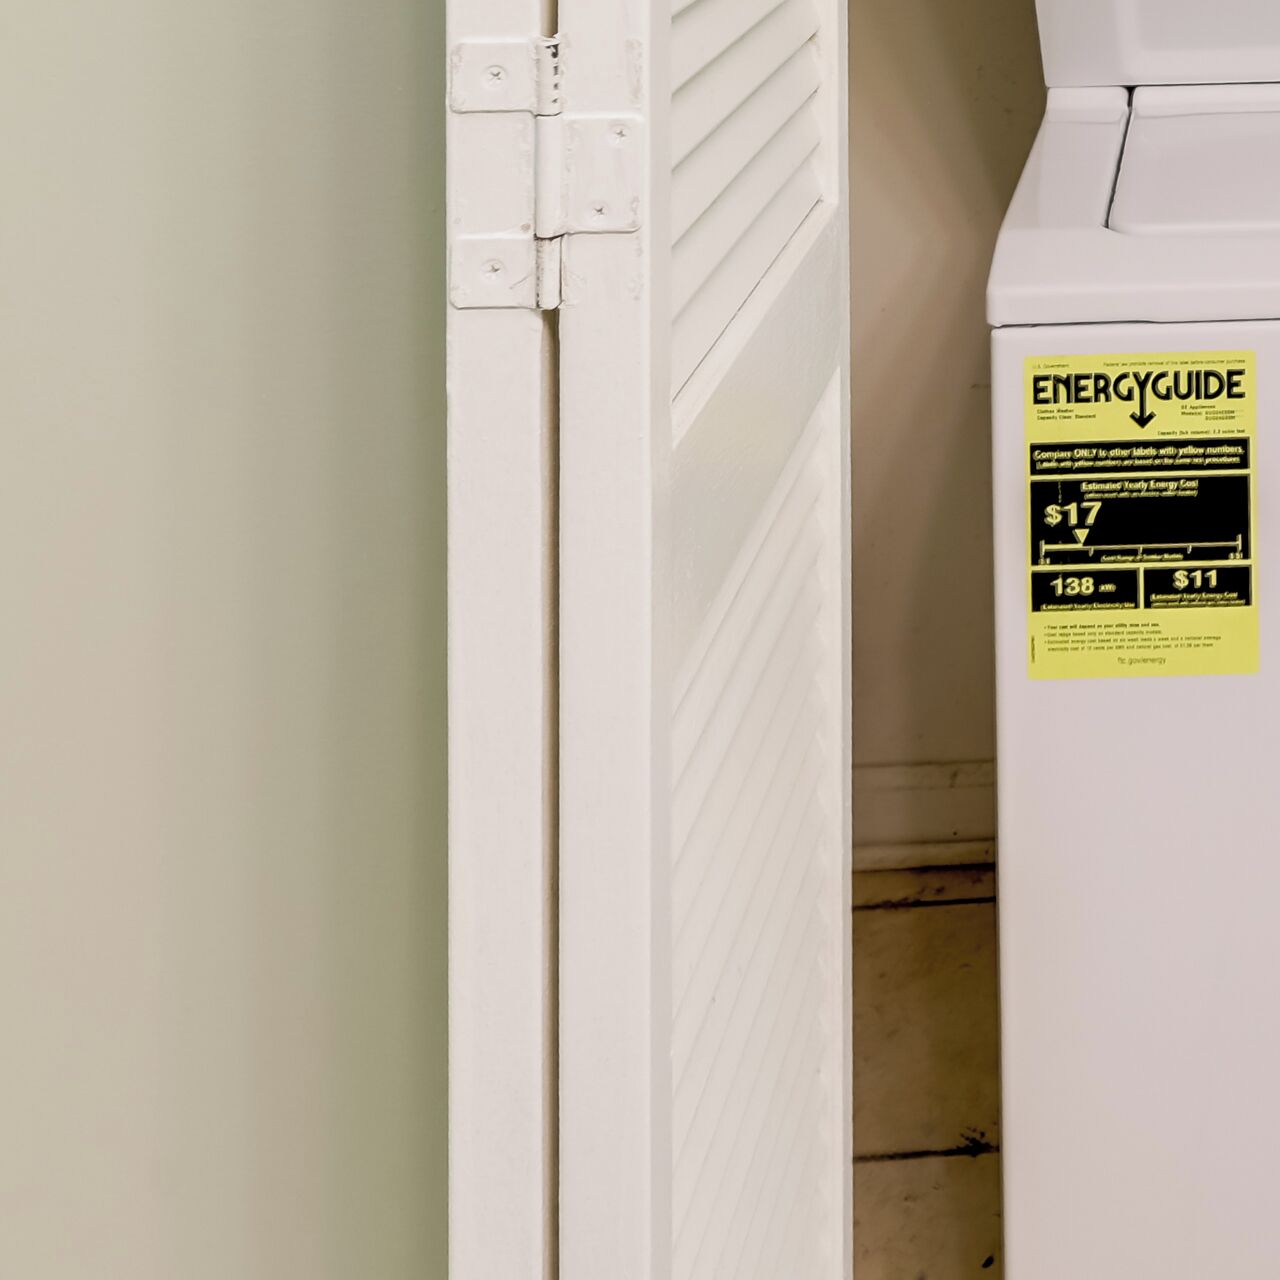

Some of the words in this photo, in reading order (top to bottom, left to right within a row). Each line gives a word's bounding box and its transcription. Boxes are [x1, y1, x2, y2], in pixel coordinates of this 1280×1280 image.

[1033, 369, 1245, 405] ENERGYGUIDE
[1033, 450, 1072, 461] Compare
[1074, 448, 1097, 459] ONLY
[1098, 448, 1108, 458] to
[1109, 448, 1131, 458] other
[1132, 447, 1157, 457] labels
[1158, 446, 1177, 456] with
[1176, 445, 1204, 458] yellow
[1205, 445, 1245, 455] numbers.
[1081, 481, 1122, 492] Estimated
[1123, 480, 1148, 493] Yearly
[1148, 480, 1178, 491] Energy
[1179, 479, 1199, 489] Cost
[1044, 501, 1102, 526] $17
[1050, 576, 1095, 597] 138
[1173, 569, 1217, 591] $11
